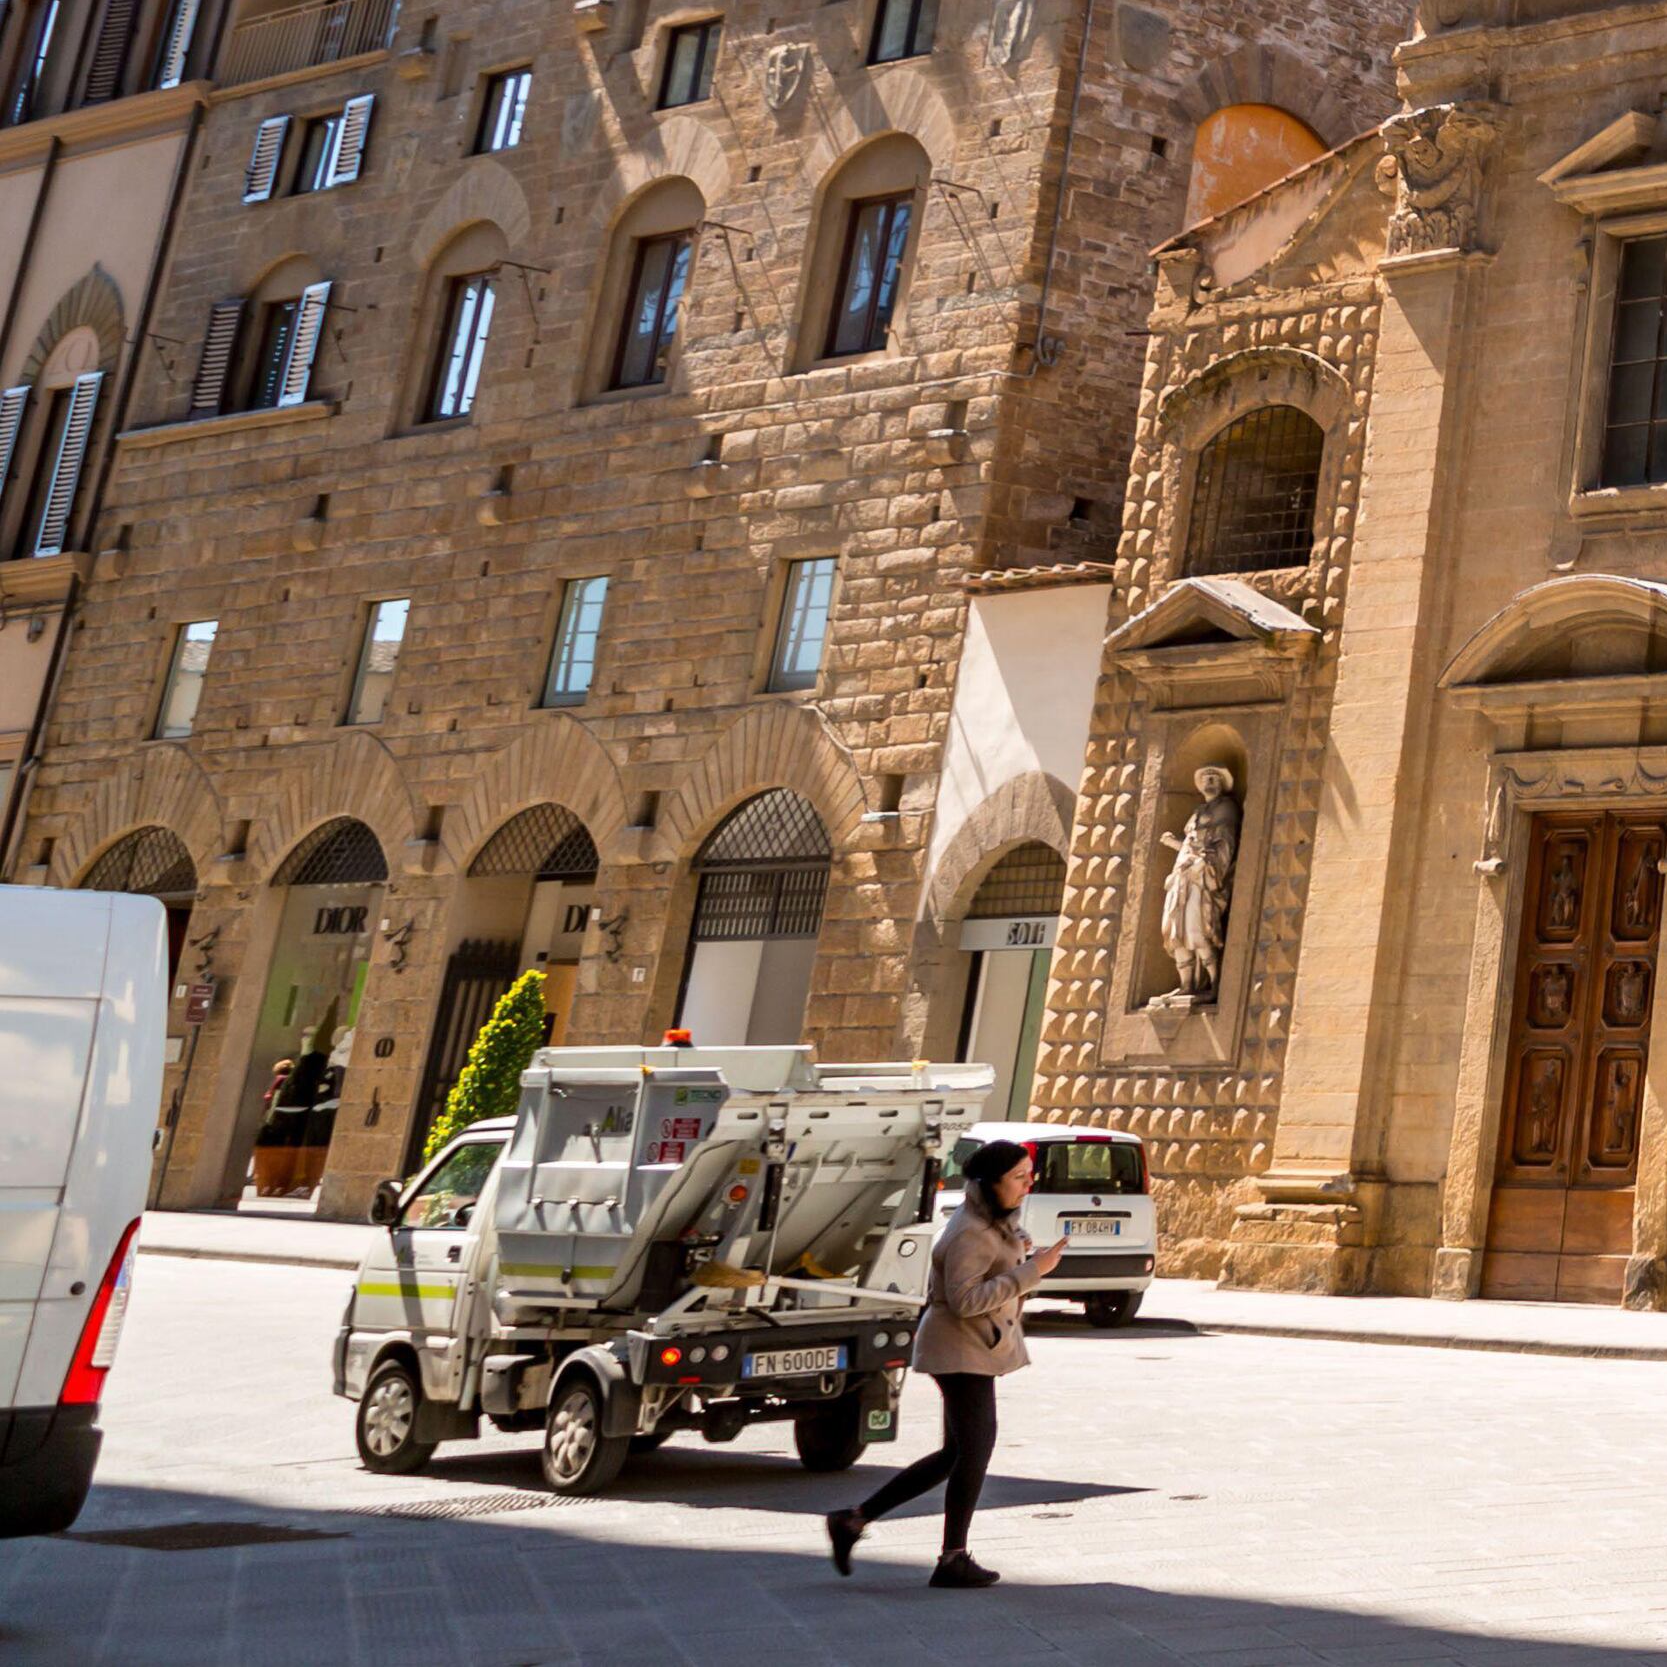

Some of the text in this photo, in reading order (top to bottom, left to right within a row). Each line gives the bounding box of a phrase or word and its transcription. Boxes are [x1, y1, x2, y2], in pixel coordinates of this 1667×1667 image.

[313, 906, 369, 935] DIOR
[562, 904, 592, 934] DI
[601, 1106, 634, 1133] Alia
[755, 1349, 837, 1374] FN 600DE
